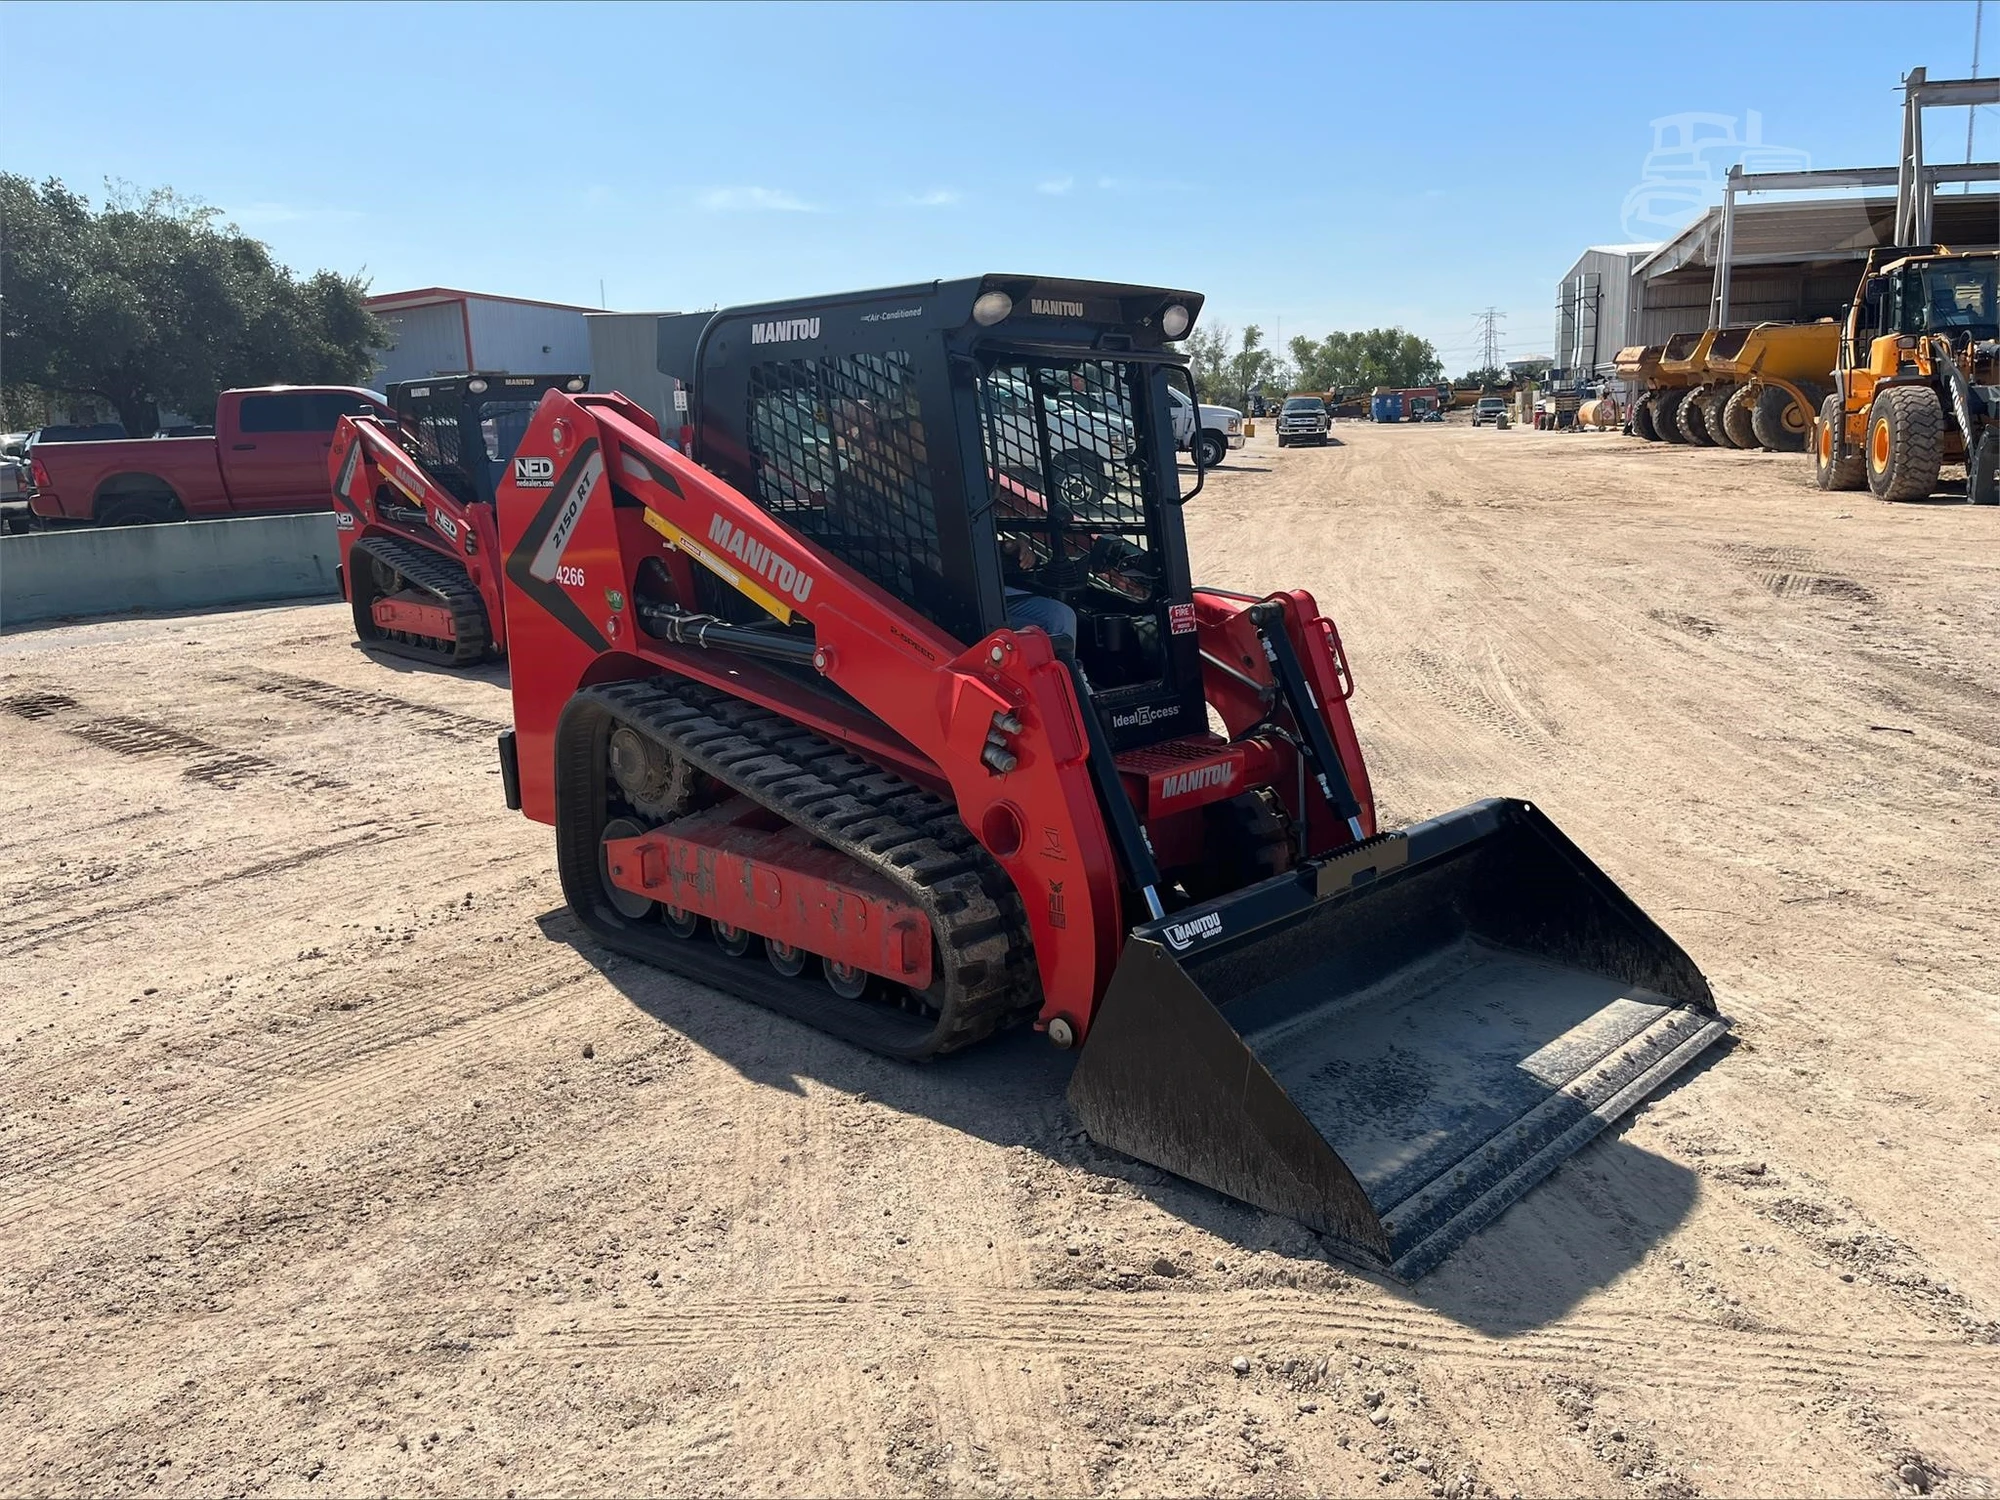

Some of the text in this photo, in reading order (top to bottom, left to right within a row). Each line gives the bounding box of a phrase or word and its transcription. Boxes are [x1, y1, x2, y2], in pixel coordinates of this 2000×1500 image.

[870, 306, 922, 321] Air-Conditioned
[1031, 299, 1084, 317] MANITOU
[752, 317, 821, 345] MANITOU
[515, 459, 554, 478] NED
[396, 465, 426, 498] MANITOU
[516, 480, 555, 488] nedealers.com
[335, 513, 353, 525] NED
[435, 507, 457, 536] NED
[553, 472, 592, 549] 2150 RT
[708, 512, 813, 603] MANITOU
[556, 565, 585, 587] 4266
[1174, 608, 1190, 617] FIRE
[1162, 761, 1232, 799] MANITOU
[1174, 912, 1221, 941] MANITOU
[1202, 926, 1223, 939] GROUP
